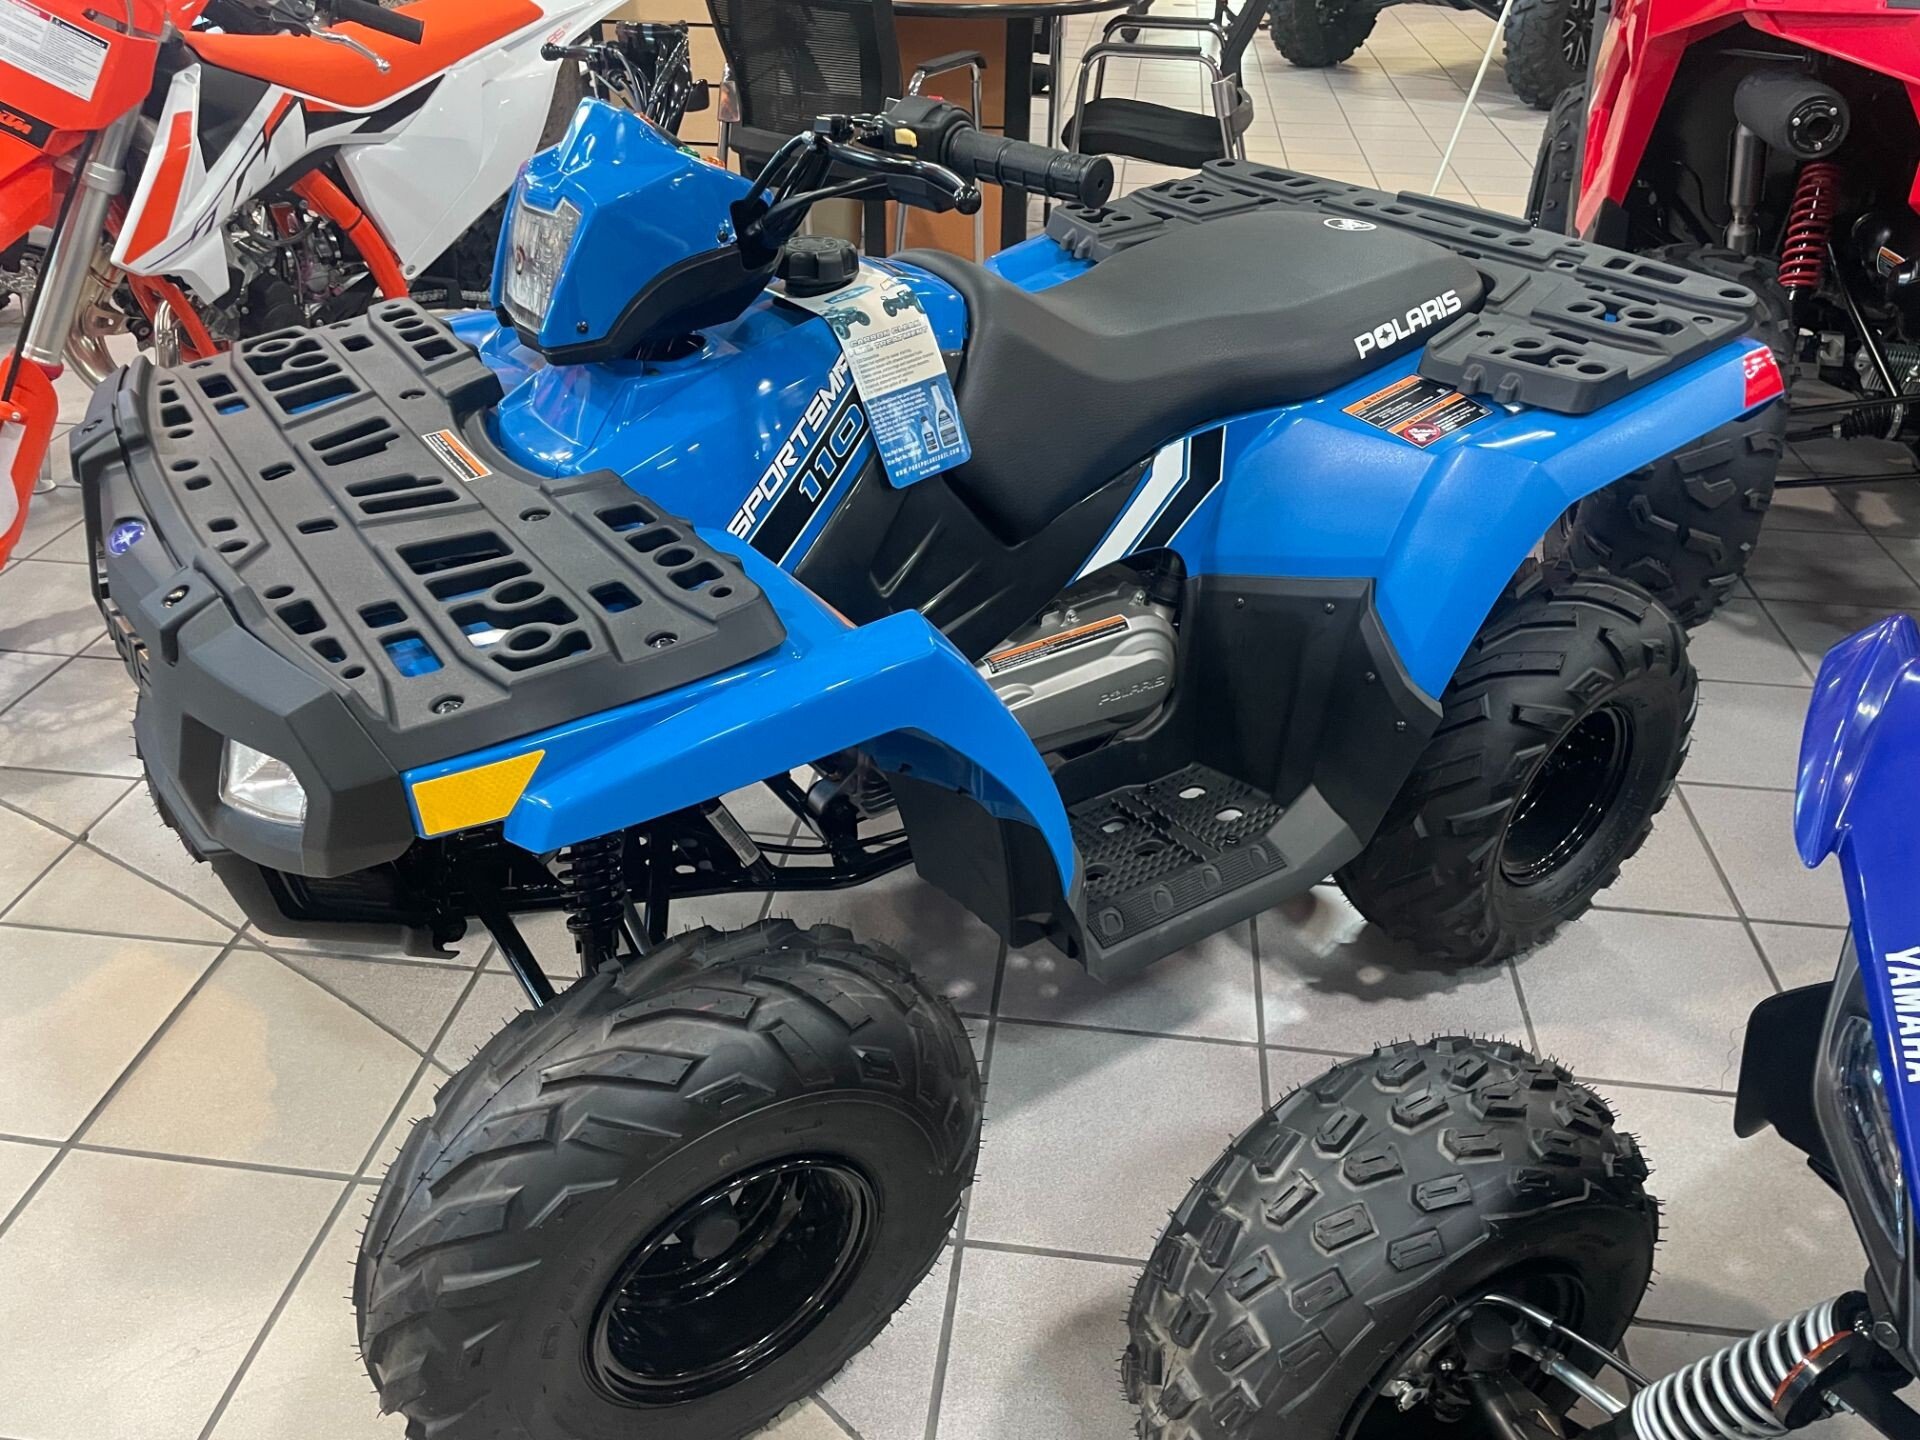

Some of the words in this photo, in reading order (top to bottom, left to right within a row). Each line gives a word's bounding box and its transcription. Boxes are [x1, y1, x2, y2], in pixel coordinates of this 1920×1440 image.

[849, 329, 891, 348] CARBON
[1353, 289, 1462, 360] POLARIS
[726, 351, 849, 540] SPORTSMA
[799, 403, 865, 503] 110
[1098, 675, 1167, 706] POLARIS
